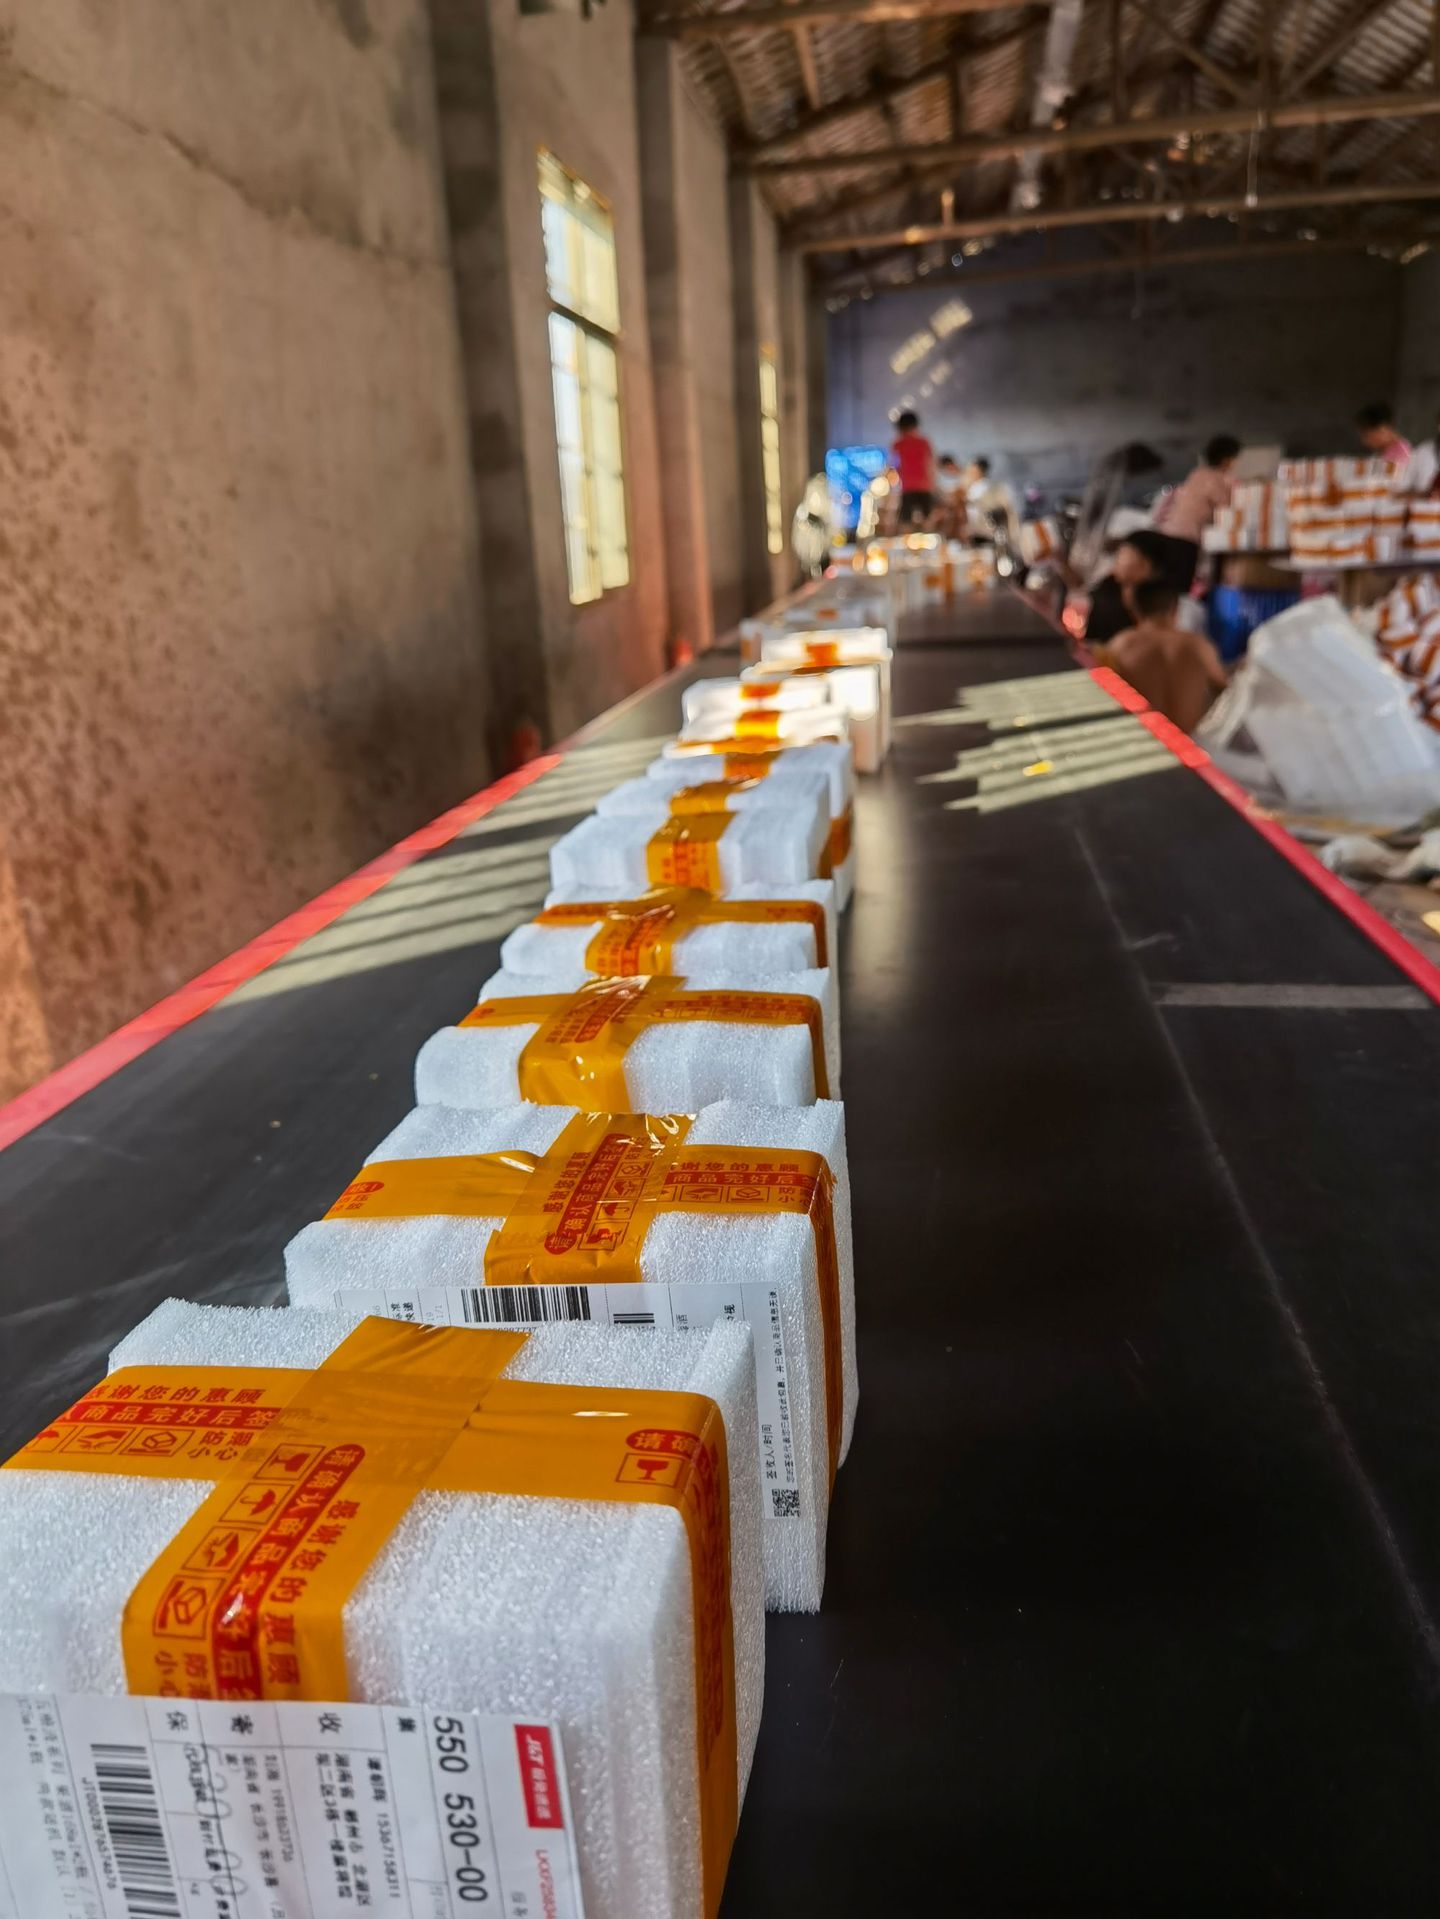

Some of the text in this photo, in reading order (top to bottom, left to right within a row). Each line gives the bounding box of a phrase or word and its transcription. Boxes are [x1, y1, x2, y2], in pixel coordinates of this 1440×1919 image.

[199, 1430, 255, 1447] 防潮
[187, 1448, 239, 1461] 小心
[263, 1500, 361, 1686] 感谢您的惠顾
[166, 1711, 189, 1732] 保
[230, 1705, 254, 1734] 寄
[318, 1712, 343, 1734] 收
[526, 1733, 544, 1766] J&T
[434, 1715, 488, 1903] 550 530-00
